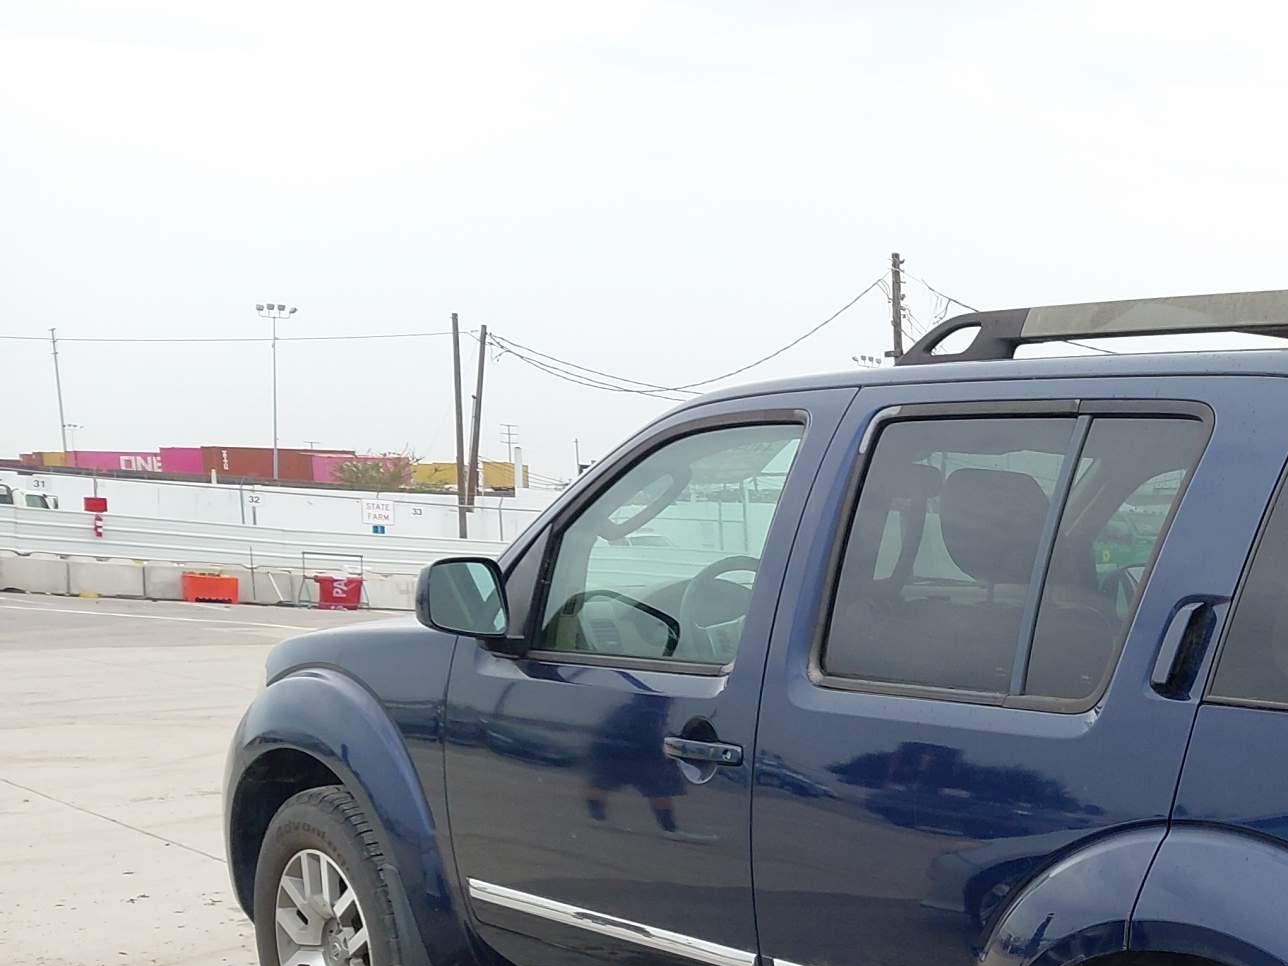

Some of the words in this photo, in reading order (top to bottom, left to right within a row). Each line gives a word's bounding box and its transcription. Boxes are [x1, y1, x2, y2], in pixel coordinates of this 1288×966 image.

[119, 454, 163, 473] ONE
[33, 479, 45, 488] 31
[248, 495, 260, 504] 32
[366, 503, 390, 511] STATE
[412, 507, 423, 516] 33
